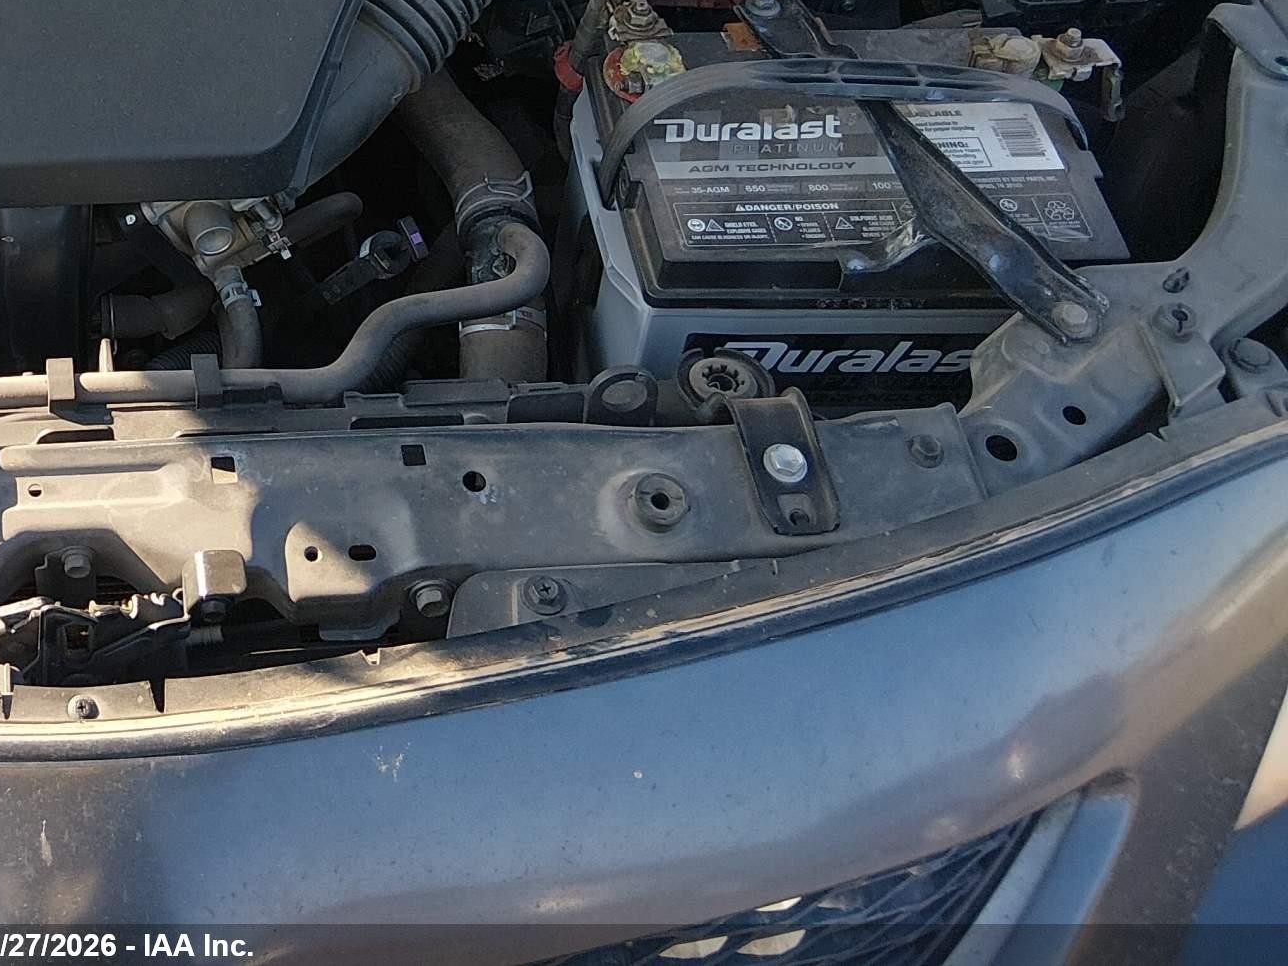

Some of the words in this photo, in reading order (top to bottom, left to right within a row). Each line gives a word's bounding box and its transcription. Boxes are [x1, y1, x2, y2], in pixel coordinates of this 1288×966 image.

[653, 114, 843, 143] Duralast
[732, 142, 845, 154] PLATINUM
[936, 141, 969, 149] NING:
[688, 163, 730, 173] AGM
[736, 161, 857, 172] TECHNOLOGY
[690, 185, 731, 194] 35-AGM
[745, 184, 766, 193] 650
[872, 181, 892, 190] 100
[744, 202, 839, 212] DANGER/POISON
[722, 341, 976, 373] Duralas
